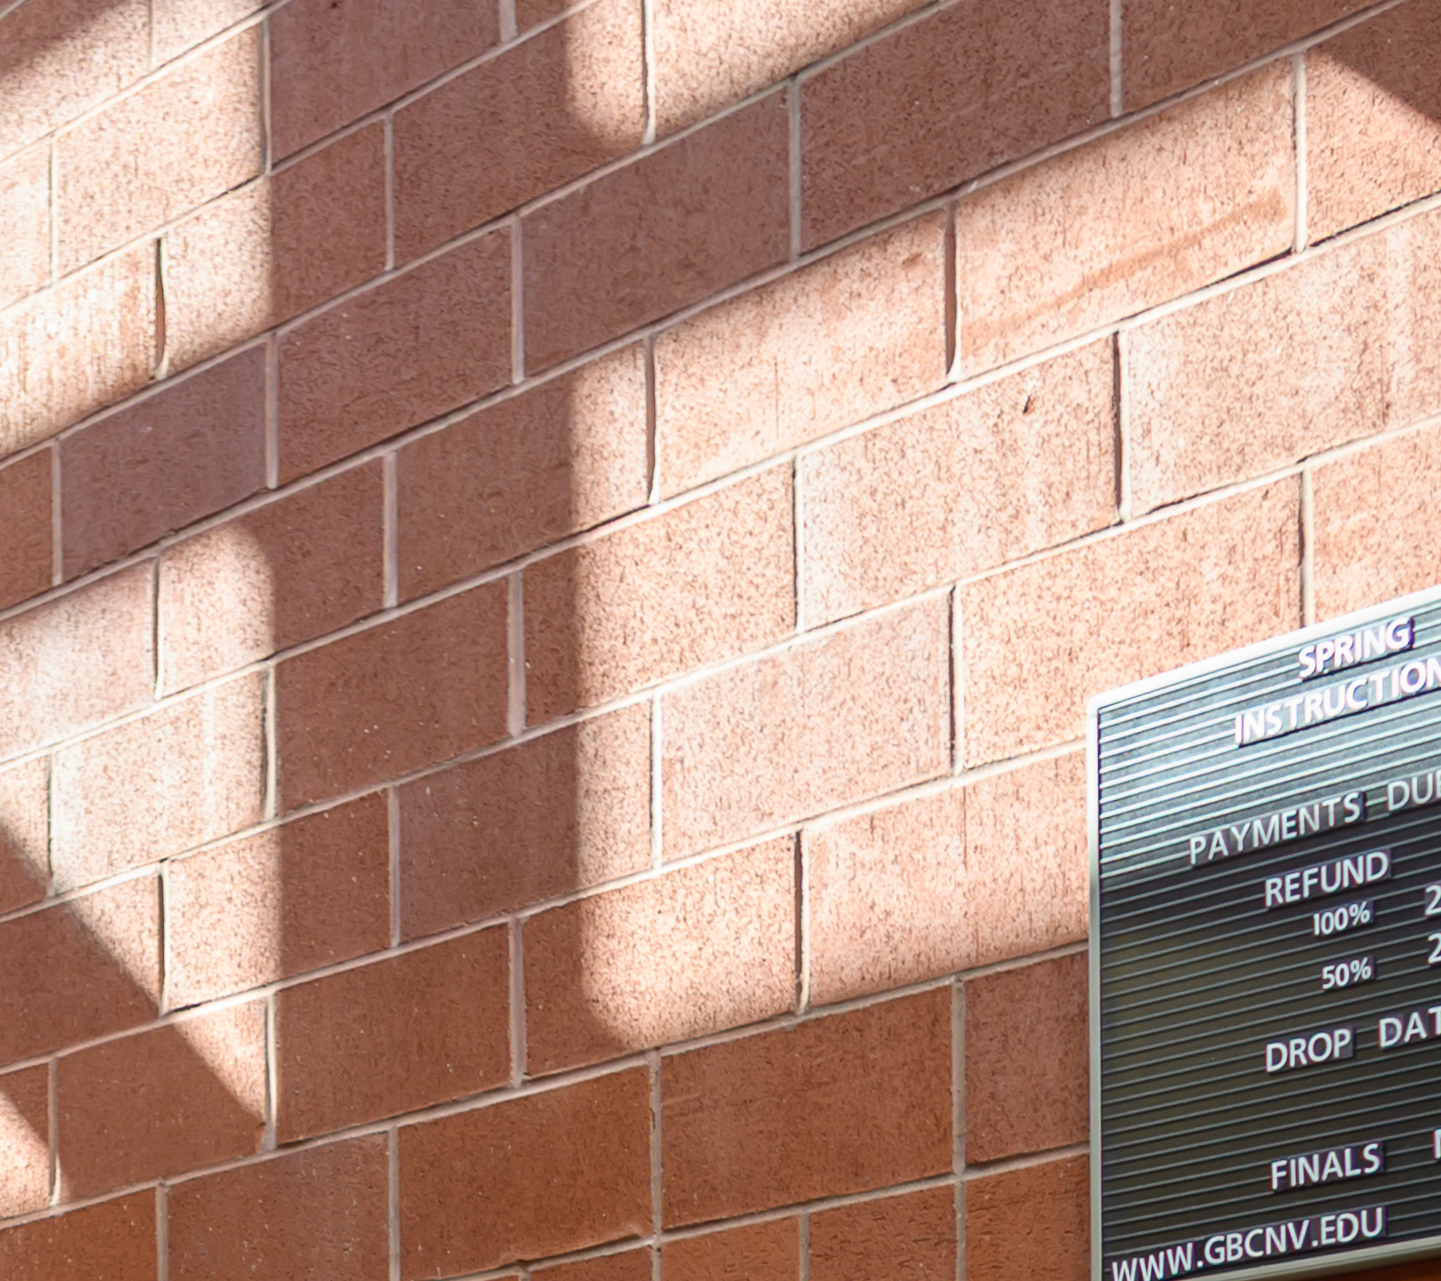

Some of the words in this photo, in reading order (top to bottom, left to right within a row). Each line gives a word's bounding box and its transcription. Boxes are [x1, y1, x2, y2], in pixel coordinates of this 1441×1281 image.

[1298, 617, 1412, 680] SPRING
[1189, 792, 1365, 866] PAYMENTS
[1265, 851, 1390, 907] REFUND
[1313, 901, 1371, 935] 100%
[1321, 957, 1372, 990] 50%
[1265, 1029, 1353, 1073] DROP
[1270, 1144, 1381, 1190] FINALS
